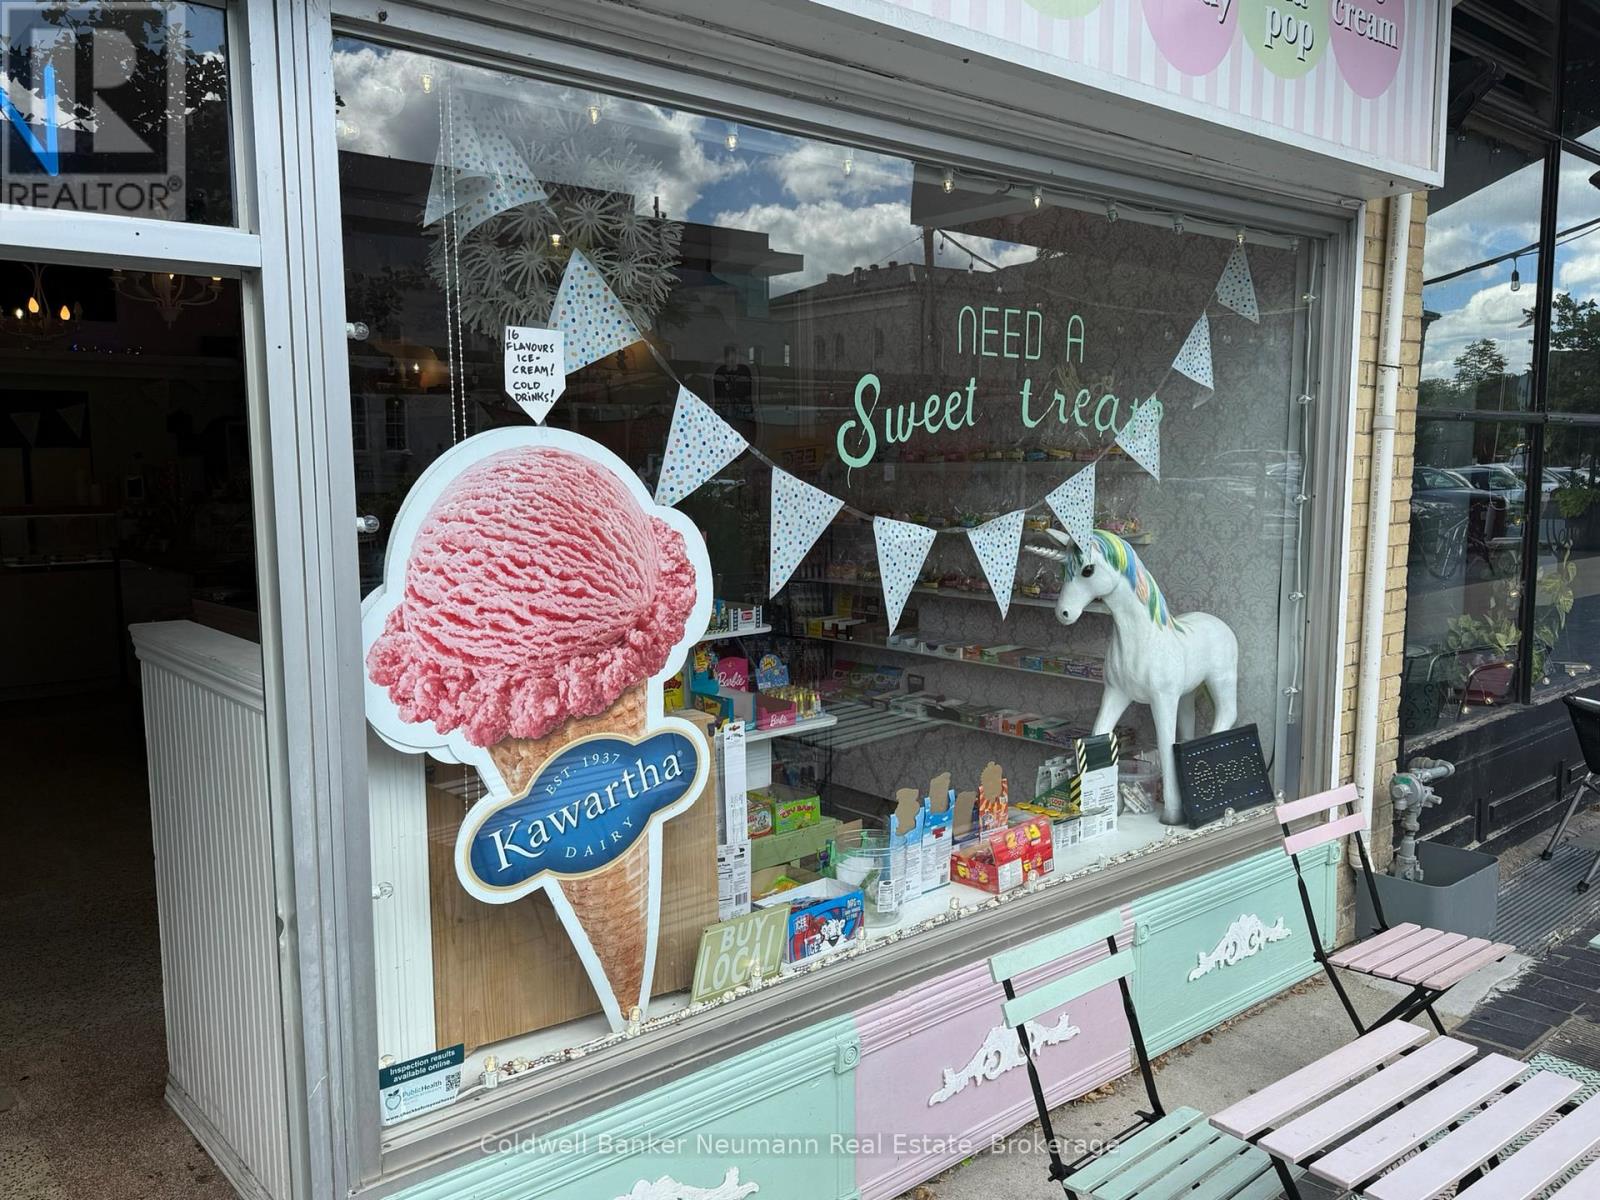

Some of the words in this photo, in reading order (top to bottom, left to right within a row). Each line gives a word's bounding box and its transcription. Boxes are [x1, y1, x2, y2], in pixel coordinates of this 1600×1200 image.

[1264, 5, 1314, 61] pop
[1332, 0, 1398, 49] cream
[506, 341, 555, 353] FLAVOURS
[507, 328, 520, 340] 16
[957, 305, 1043, 360] NEED
[1066, 314, 1085, 363] A
[512, 363, 555, 377] CREAM!
[512, 381, 541, 390] COLD
[837, 372, 983, 470] Sweet
[718, 671, 745, 689] Barbie
[545, 767, 578, 796] EST.
[582, 752, 621, 768] 1937
[565, 816, 633, 859] DAIRY
[720, 914, 768, 953] BUY
[698, 925, 776, 997] LOCAL
[390, 1058, 429, 1076] Inspection
[431, 1049, 456, 1063] results
[393, 1067, 427, 1083] available
[428, 1059, 453, 1072] online.
